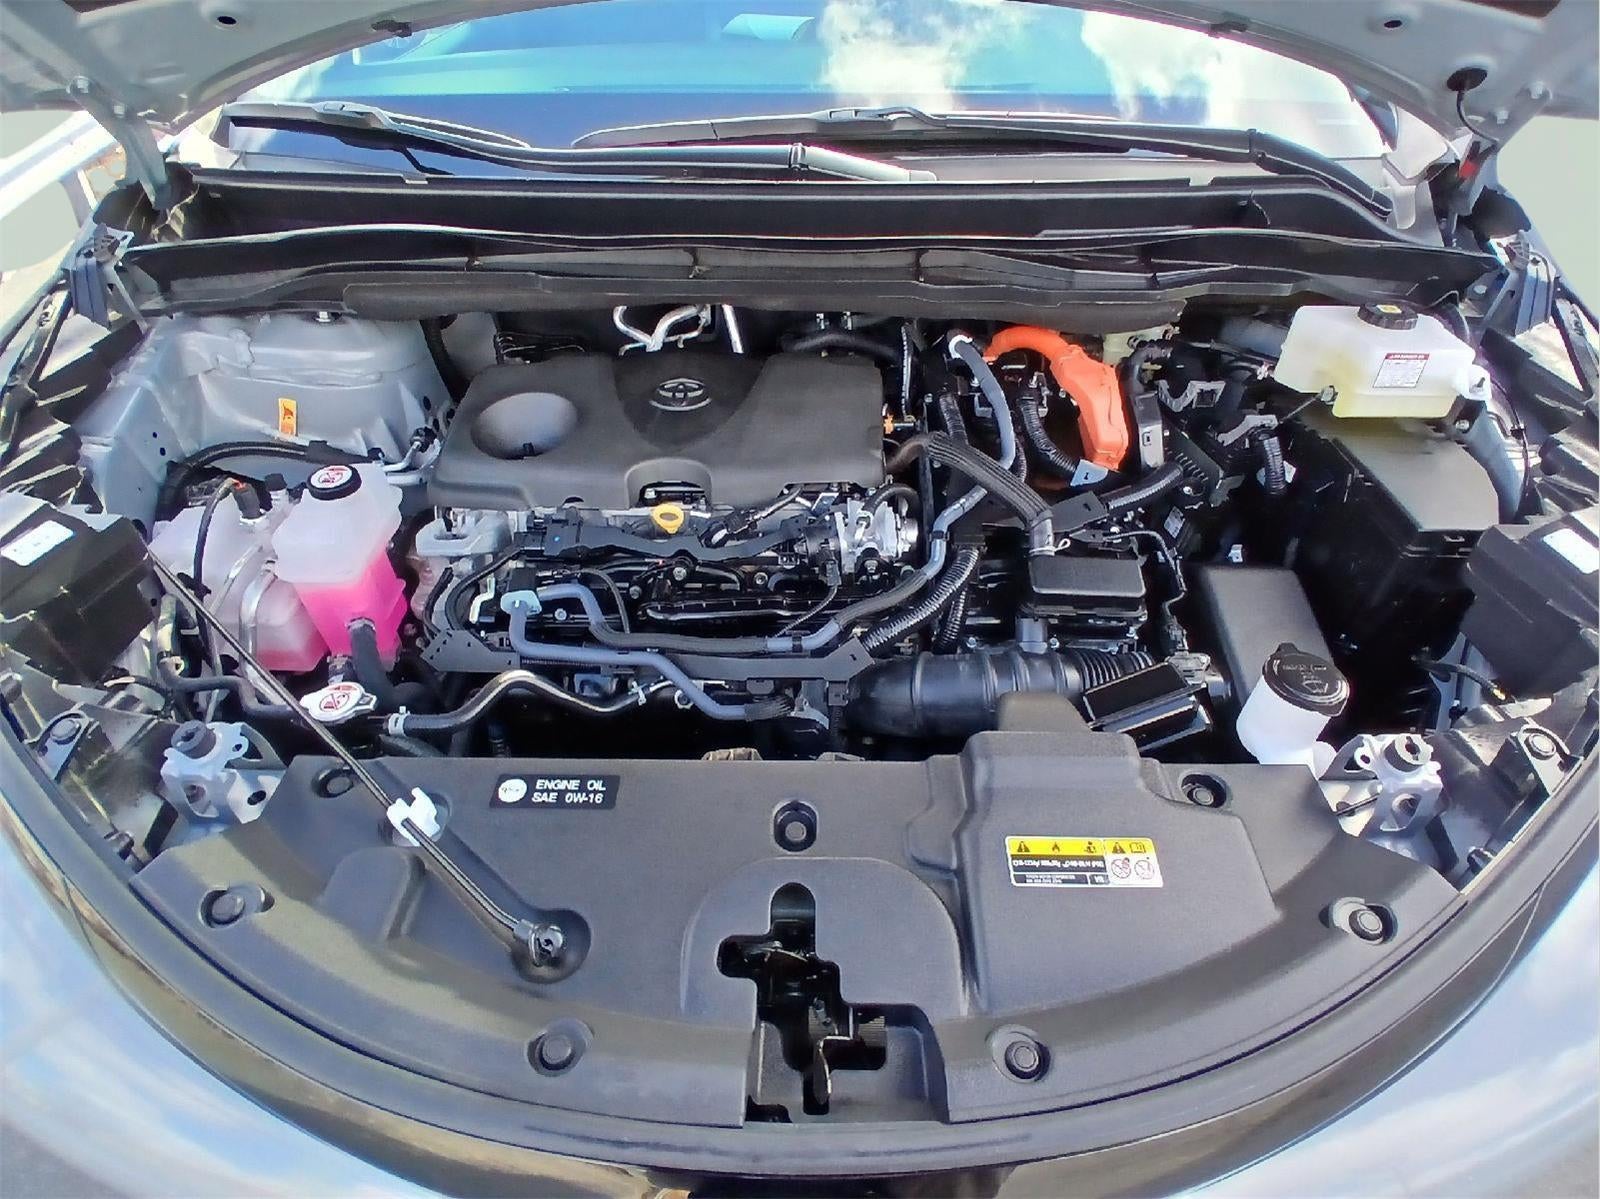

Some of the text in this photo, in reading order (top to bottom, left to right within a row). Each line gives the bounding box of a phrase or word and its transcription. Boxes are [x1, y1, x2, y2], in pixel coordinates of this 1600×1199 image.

[535, 779, 580, 790] ENGINE
[586, 779, 607, 791] OIL
[531, 792, 604, 804] SAE 0W-16
